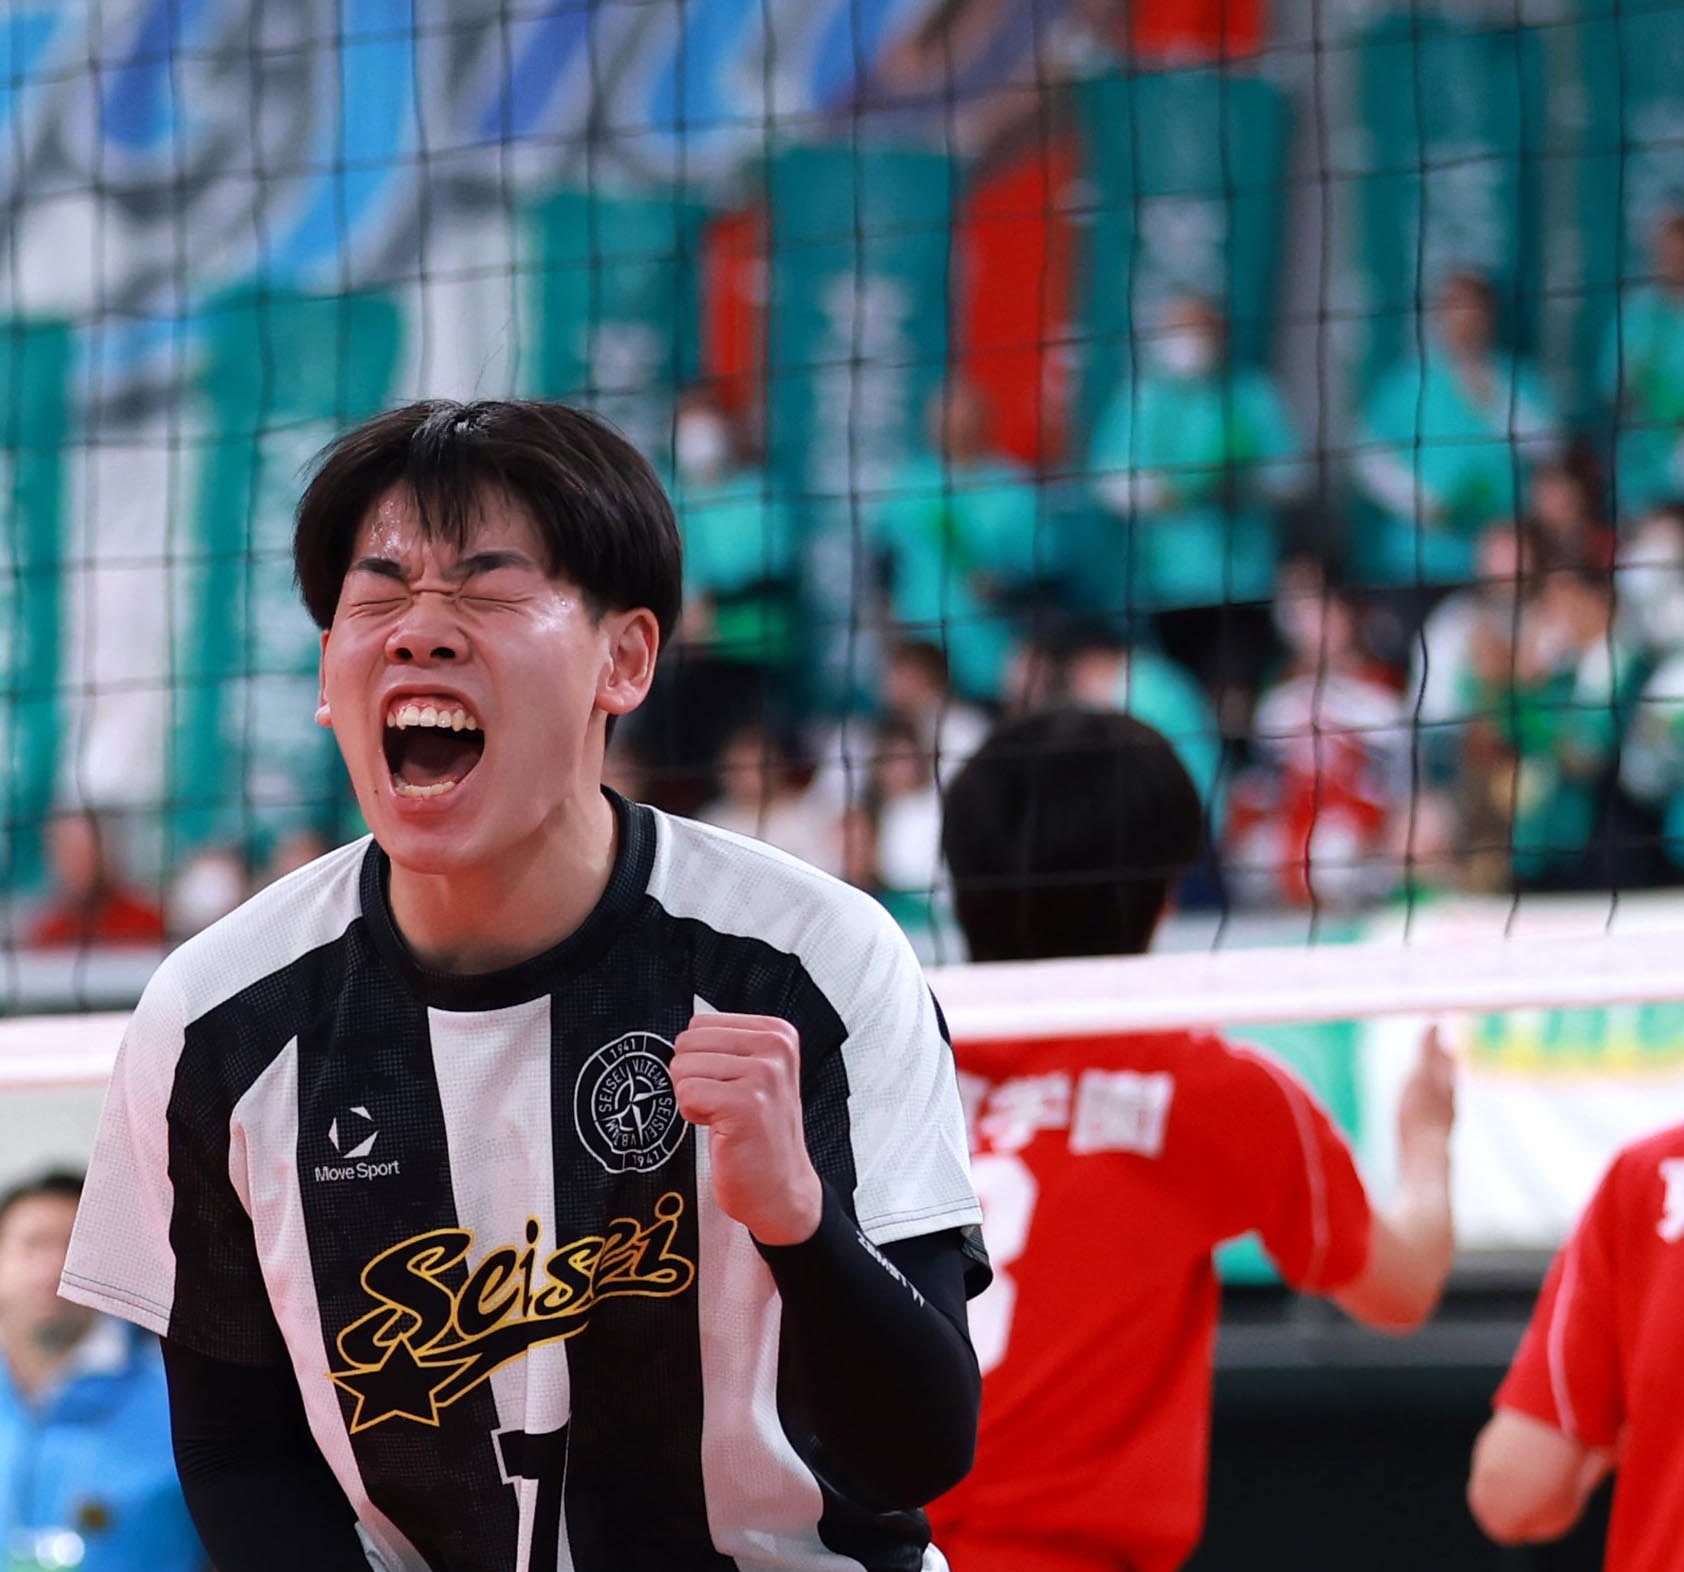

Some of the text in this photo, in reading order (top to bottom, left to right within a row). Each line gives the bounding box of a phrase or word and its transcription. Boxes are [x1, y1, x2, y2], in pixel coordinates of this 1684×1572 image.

[598, 1065, 627, 1112] SEISEI
[958, 1064, 1176, 1160] 学園
[644, 1096, 673, 1142] SEISEI
[314, 1160, 401, 1182] Move Sport
[335, 1191, 696, 1370] Seisei
